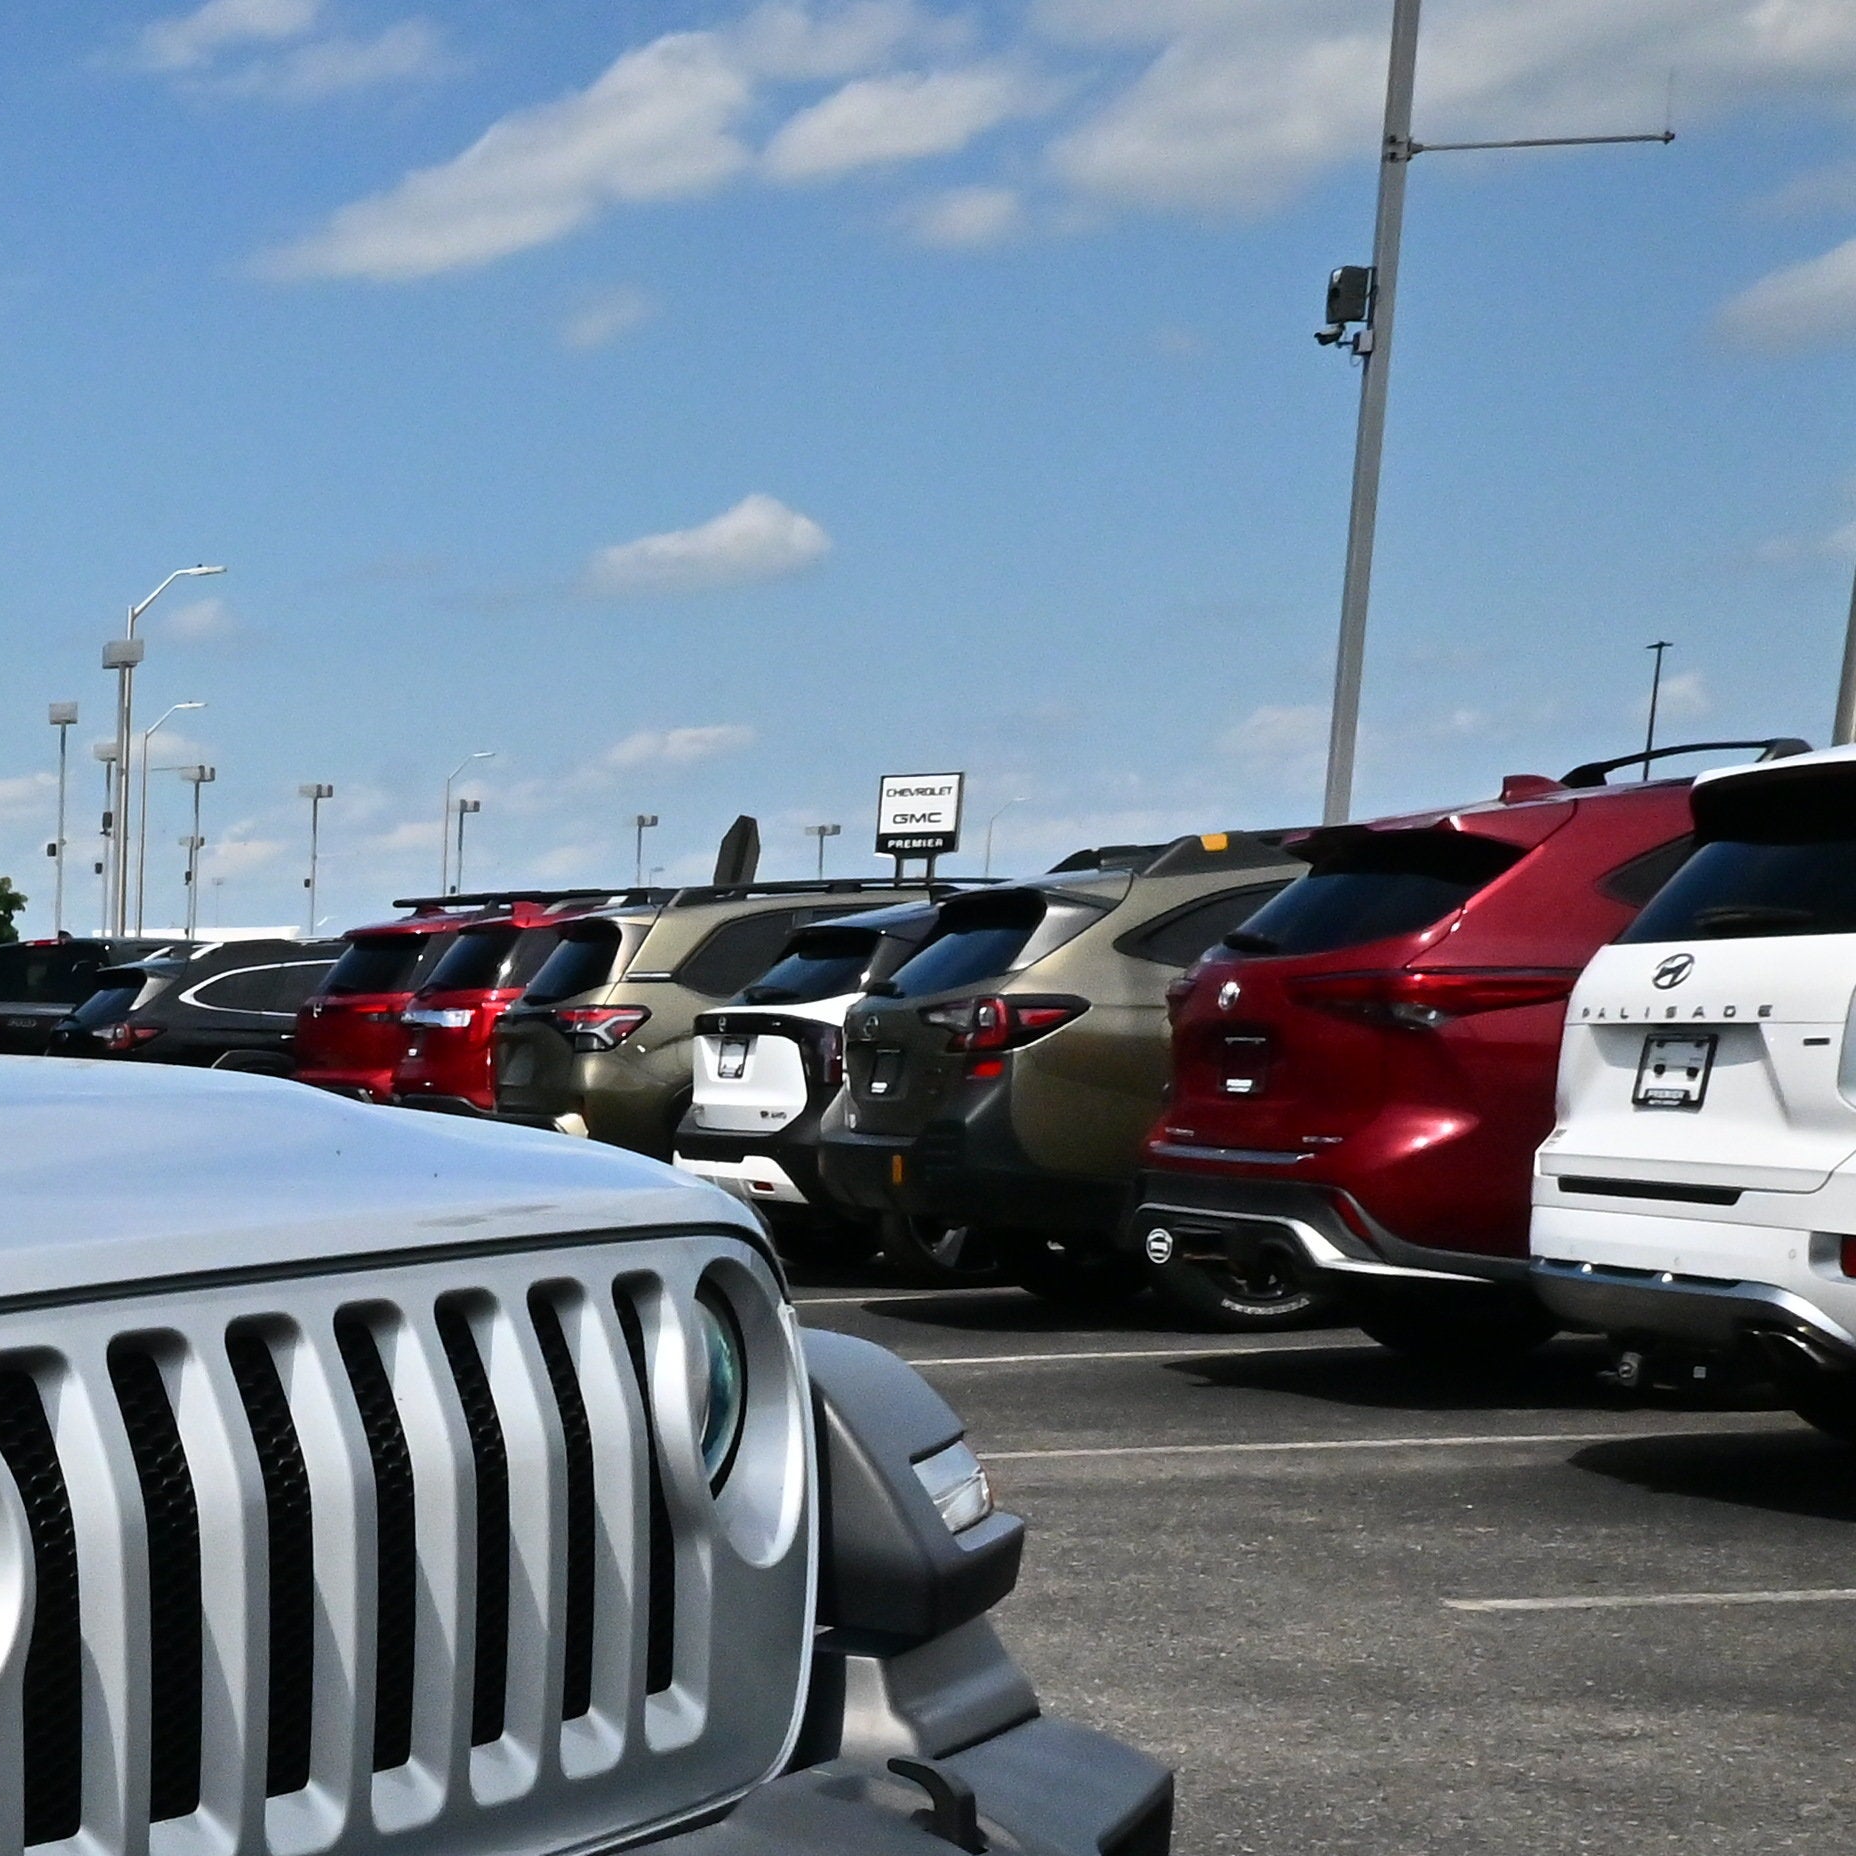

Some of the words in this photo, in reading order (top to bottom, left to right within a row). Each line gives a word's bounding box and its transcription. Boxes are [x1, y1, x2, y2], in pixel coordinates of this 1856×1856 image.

[886, 786, 953, 798] CHEVROLET
[893, 812, 943, 825] GMC
[887, 838, 944, 849] PREMIER
[1582, 1004, 1774, 1020] PALISADE
